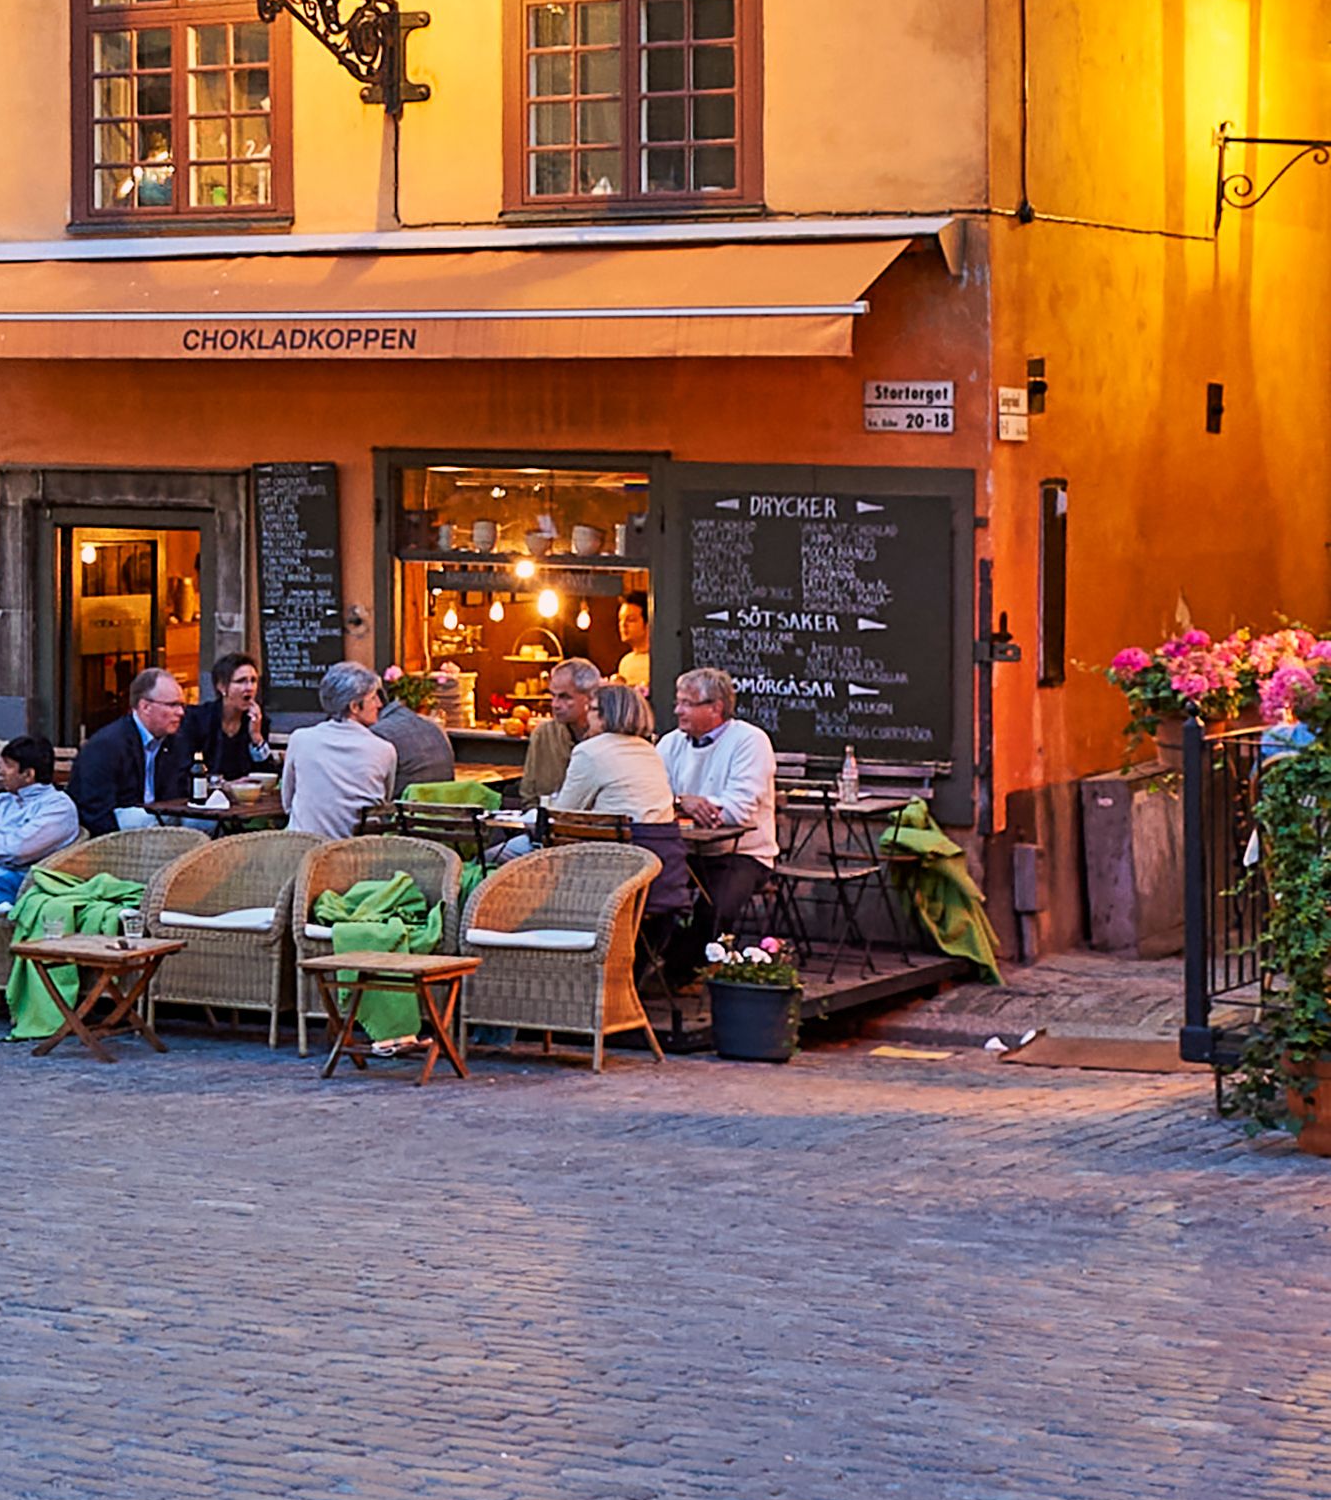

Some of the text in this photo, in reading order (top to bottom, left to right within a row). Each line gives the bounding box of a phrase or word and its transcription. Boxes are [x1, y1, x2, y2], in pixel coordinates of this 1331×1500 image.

[183, 328, 417, 351] CHOKLADKOPPEN
[875, 384, 948, 404] Stortorget
[906, 412, 949, 429] 20-18
[749, 495, 838, 519] DRYCKER
[737, 603, 840, 633] SÖTSAKER
